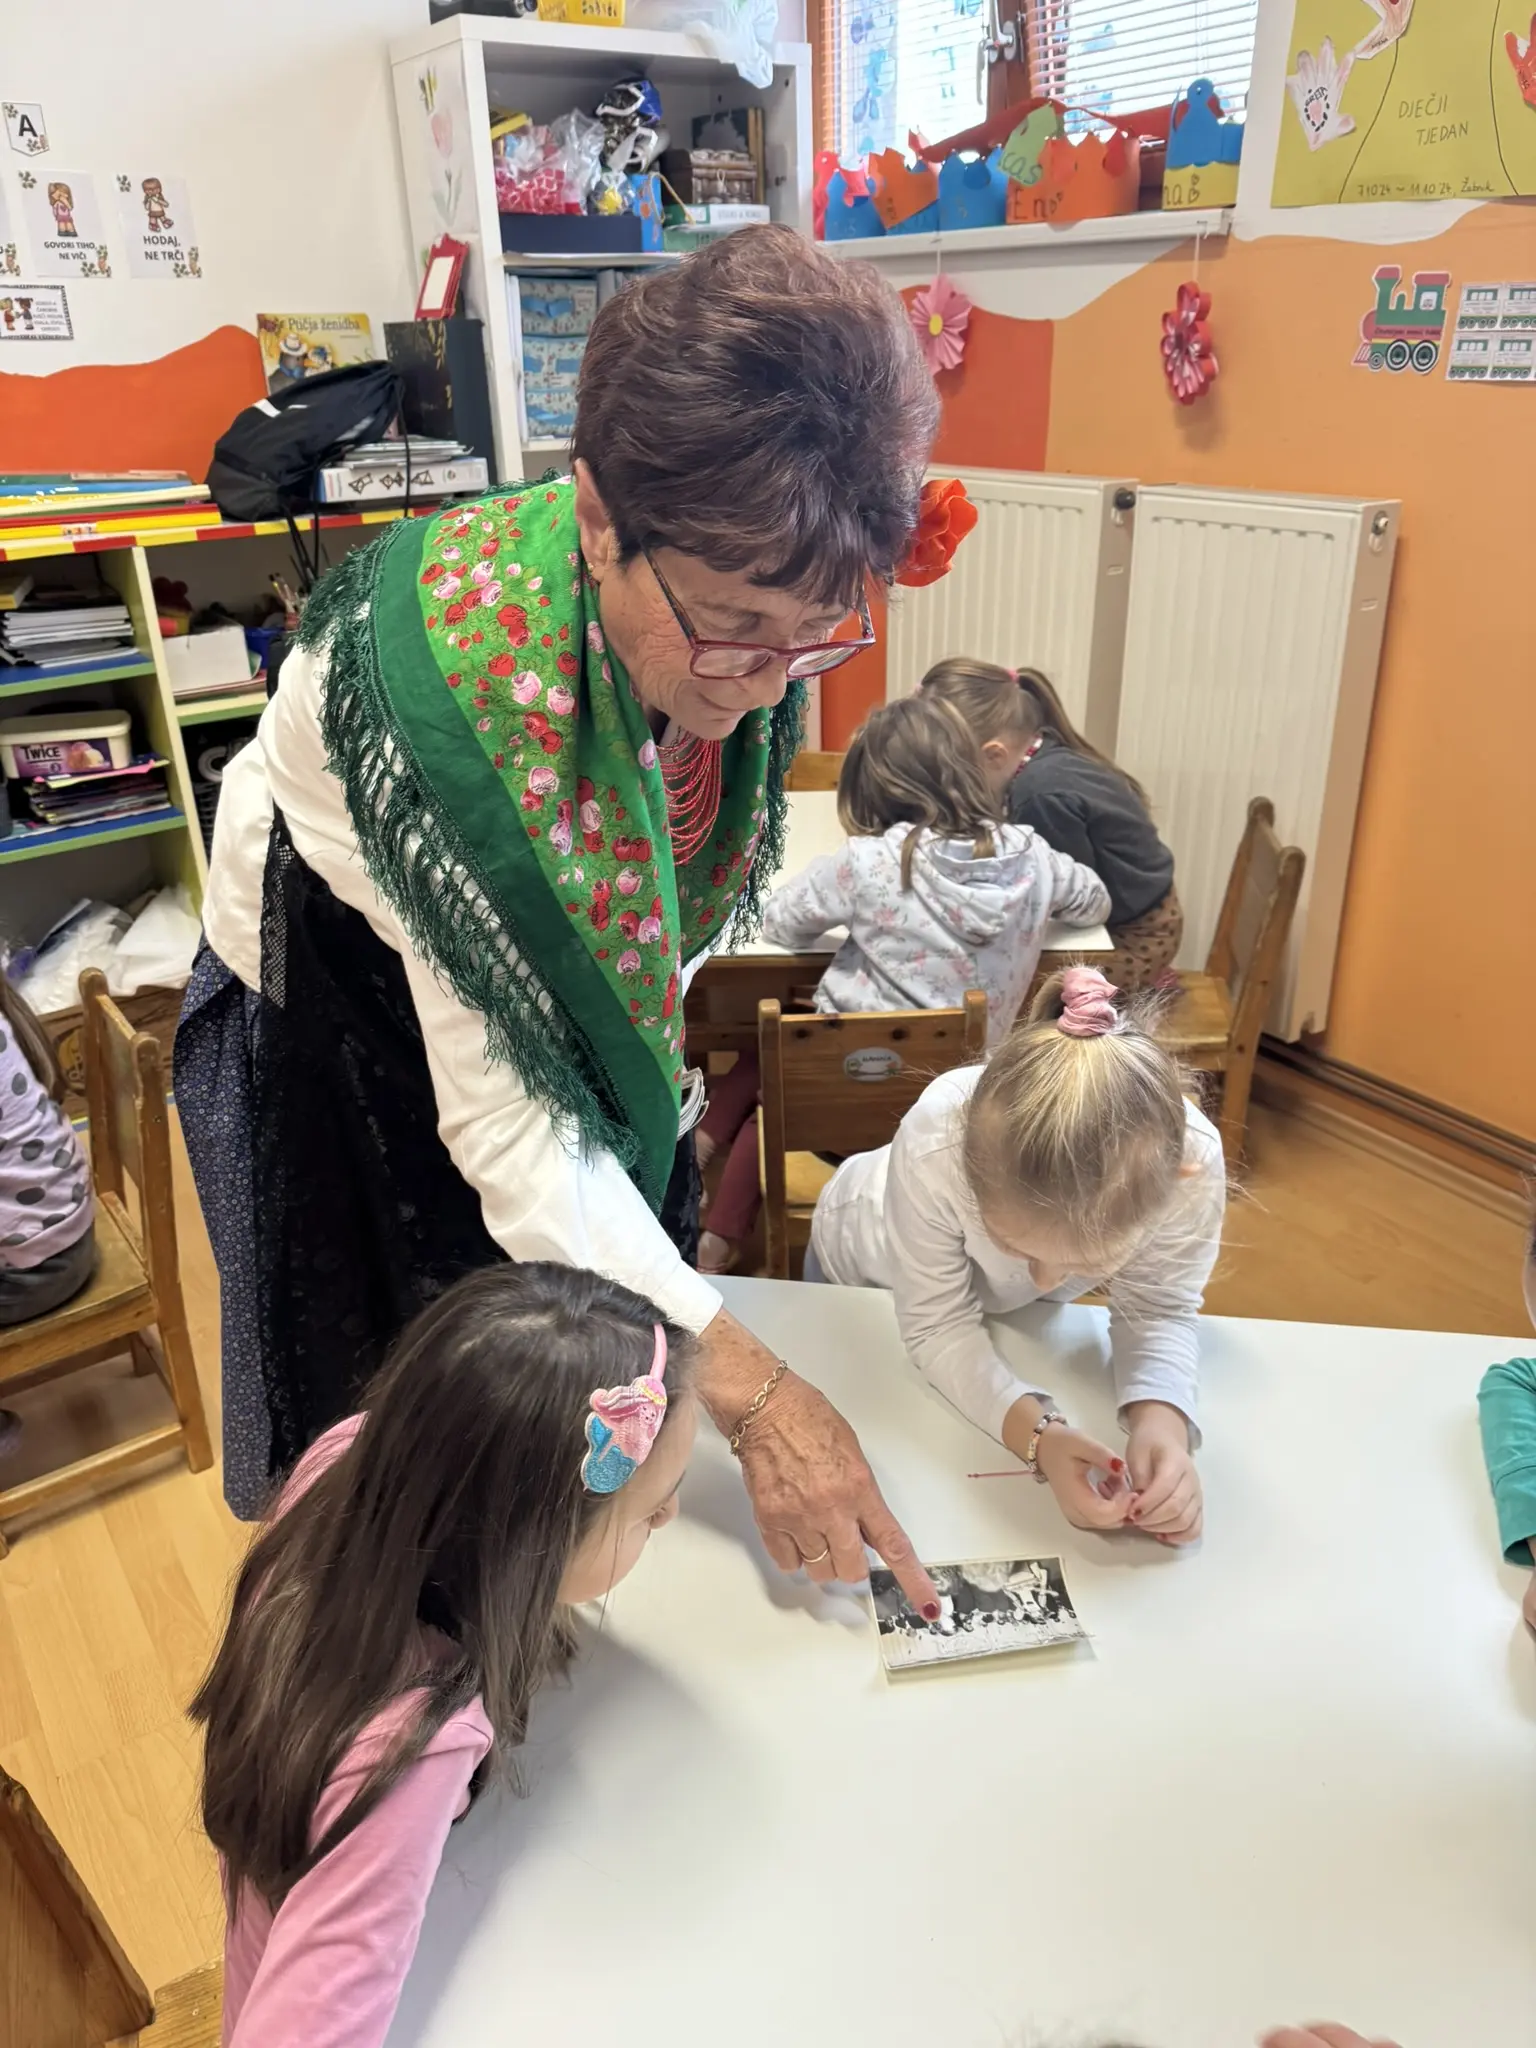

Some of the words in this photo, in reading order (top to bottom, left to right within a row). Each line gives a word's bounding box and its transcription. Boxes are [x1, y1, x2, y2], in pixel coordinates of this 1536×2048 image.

[1398, 93, 1448, 119] DJEČJI
[18, 114, 38, 138] A
[1416, 121, 1469, 146] TJEDAN
[44, 241, 75, 249] GOVORI
[59, 252, 71, 260] NE
[72, 251, 87, 260] VIČI
[144, 251, 159, 261] NE
[161, 249, 185, 261] TRČI
